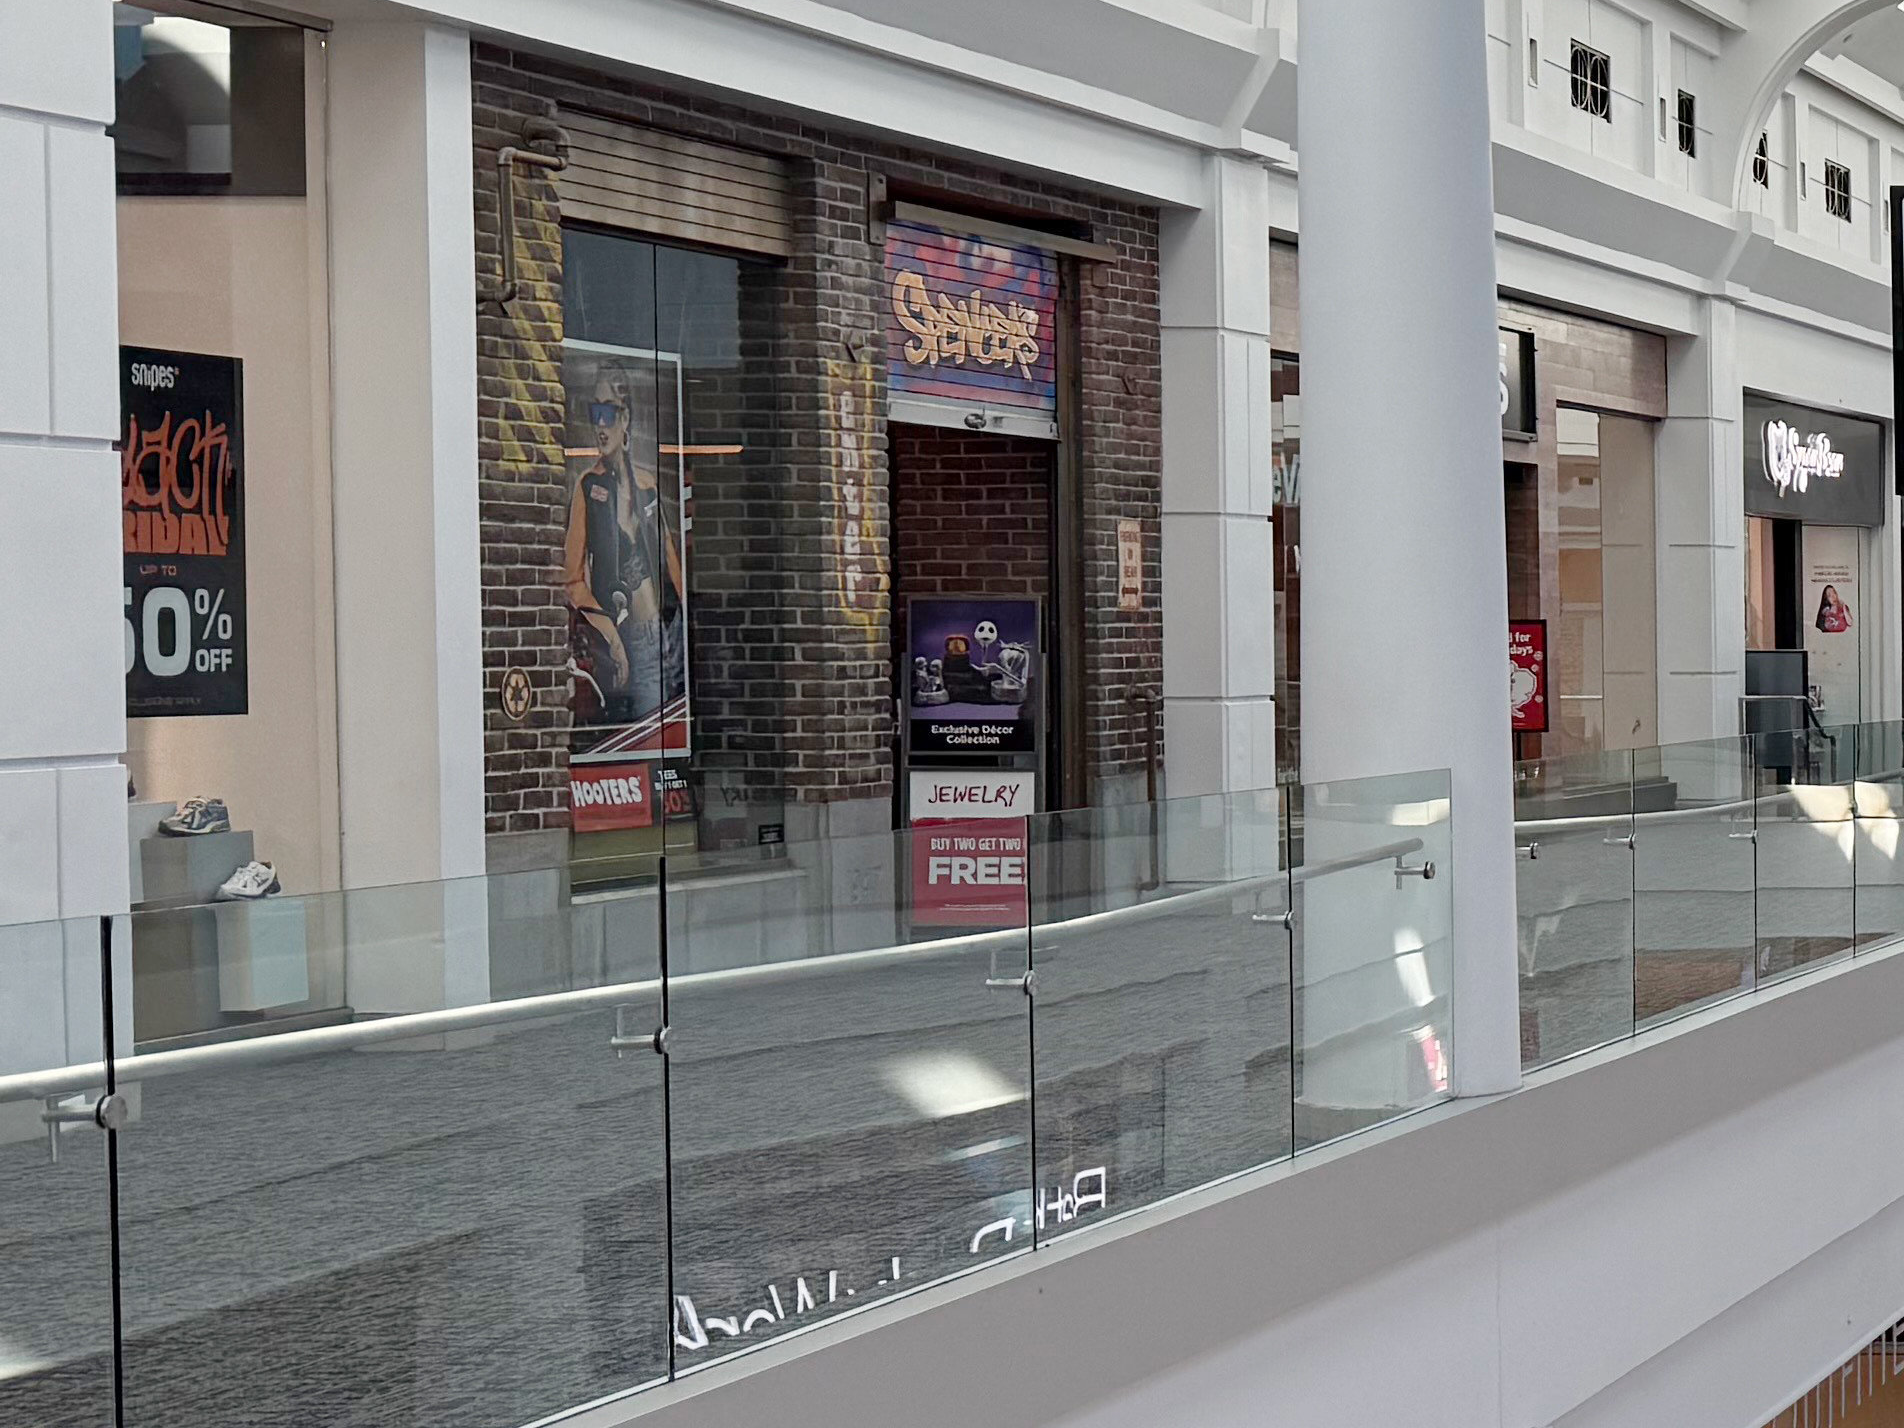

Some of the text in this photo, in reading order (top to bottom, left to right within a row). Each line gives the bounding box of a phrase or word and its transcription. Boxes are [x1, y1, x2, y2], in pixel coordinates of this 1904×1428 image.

[131, 362, 176, 391] snipes
[124, 509, 229, 555] RIDAY
[195, 648, 233, 673] OFF
[1510, 644, 1534, 656] days
[931, 724, 1014, 735] Exclusive Décor
[946, 735, 1000, 745] Collection
[570, 776, 643, 808] HOOTERS
[928, 784, 1020, 808] JEWELRY
[931, 837, 1021, 851] BUY TWO GET TWO
[928, 856, 1024, 885] FREE
